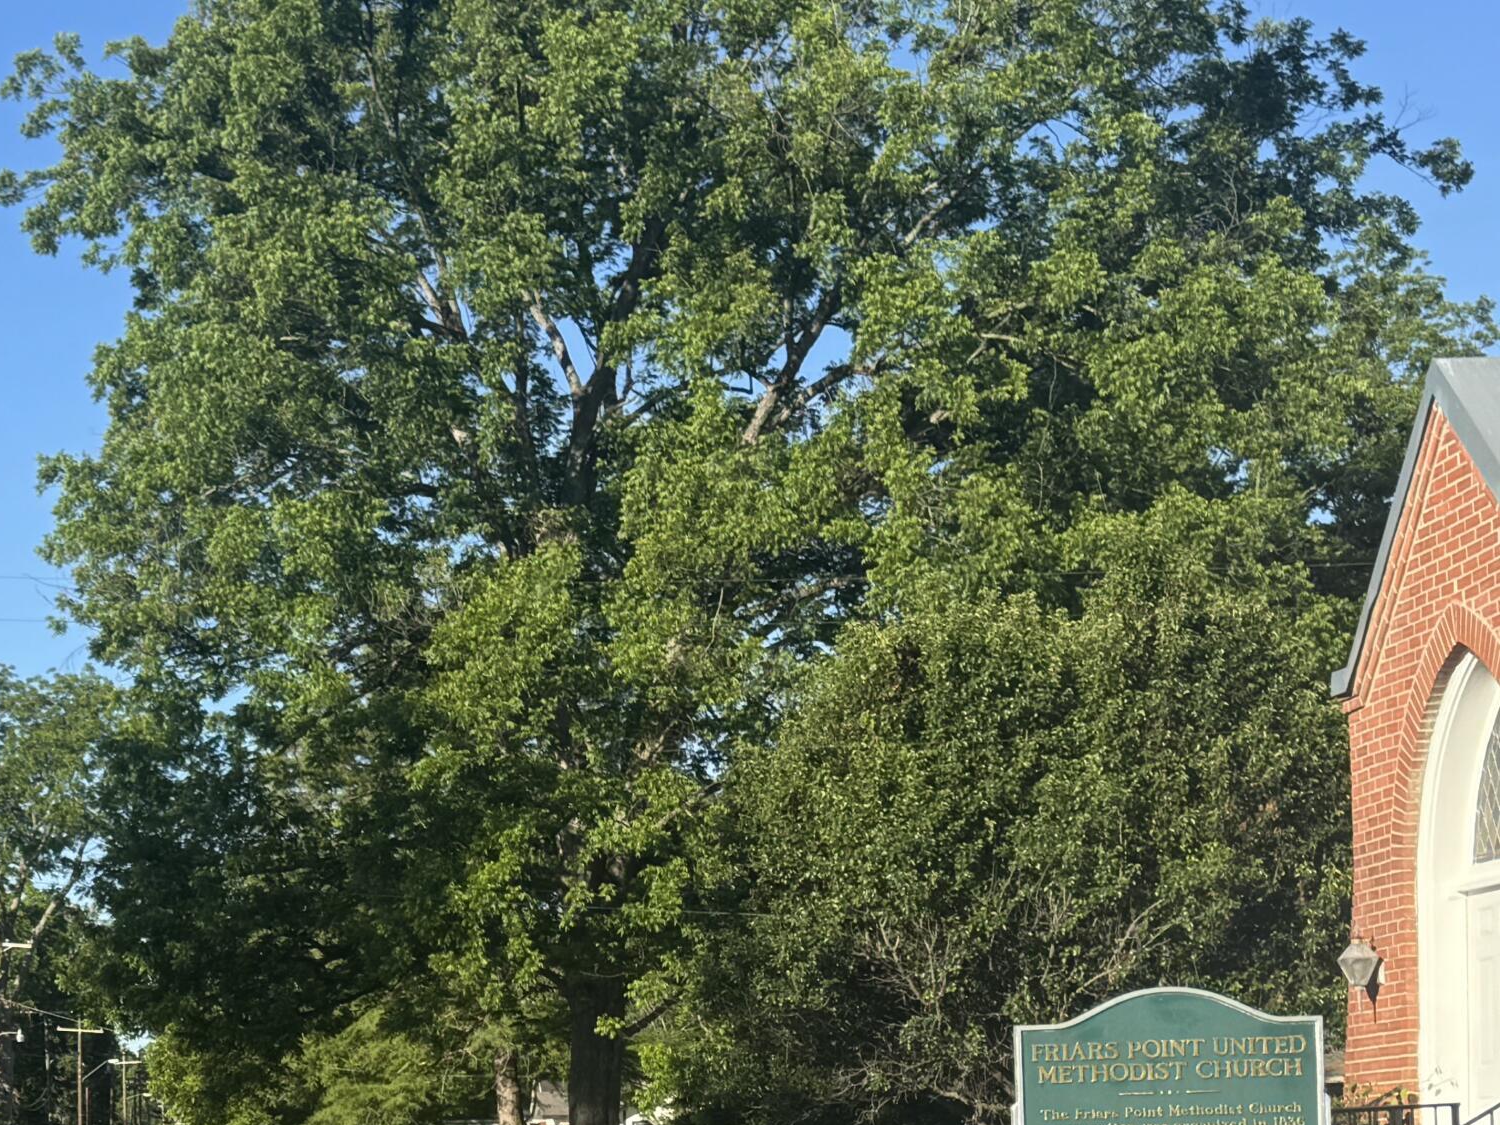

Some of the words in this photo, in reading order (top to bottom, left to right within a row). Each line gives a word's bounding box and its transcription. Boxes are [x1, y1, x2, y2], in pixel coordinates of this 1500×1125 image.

[1031, 1041, 1120, 1062] FRIARS
[1127, 1038, 1205, 1059] POINT
[1213, 1035, 1307, 1055] UNITED
[1038, 1062, 1188, 1084] METHODIST
[1196, 1058, 1303, 1079] CHURCH
[1040, 1108, 1069, 1121] The
[1075, 1107, 1119, 1120] Friars
[1124, 1105, 1164, 1118] Point
[1169, 1103, 1244, 1118] Methodist
[1249, 1101, 1302, 1115] Church
